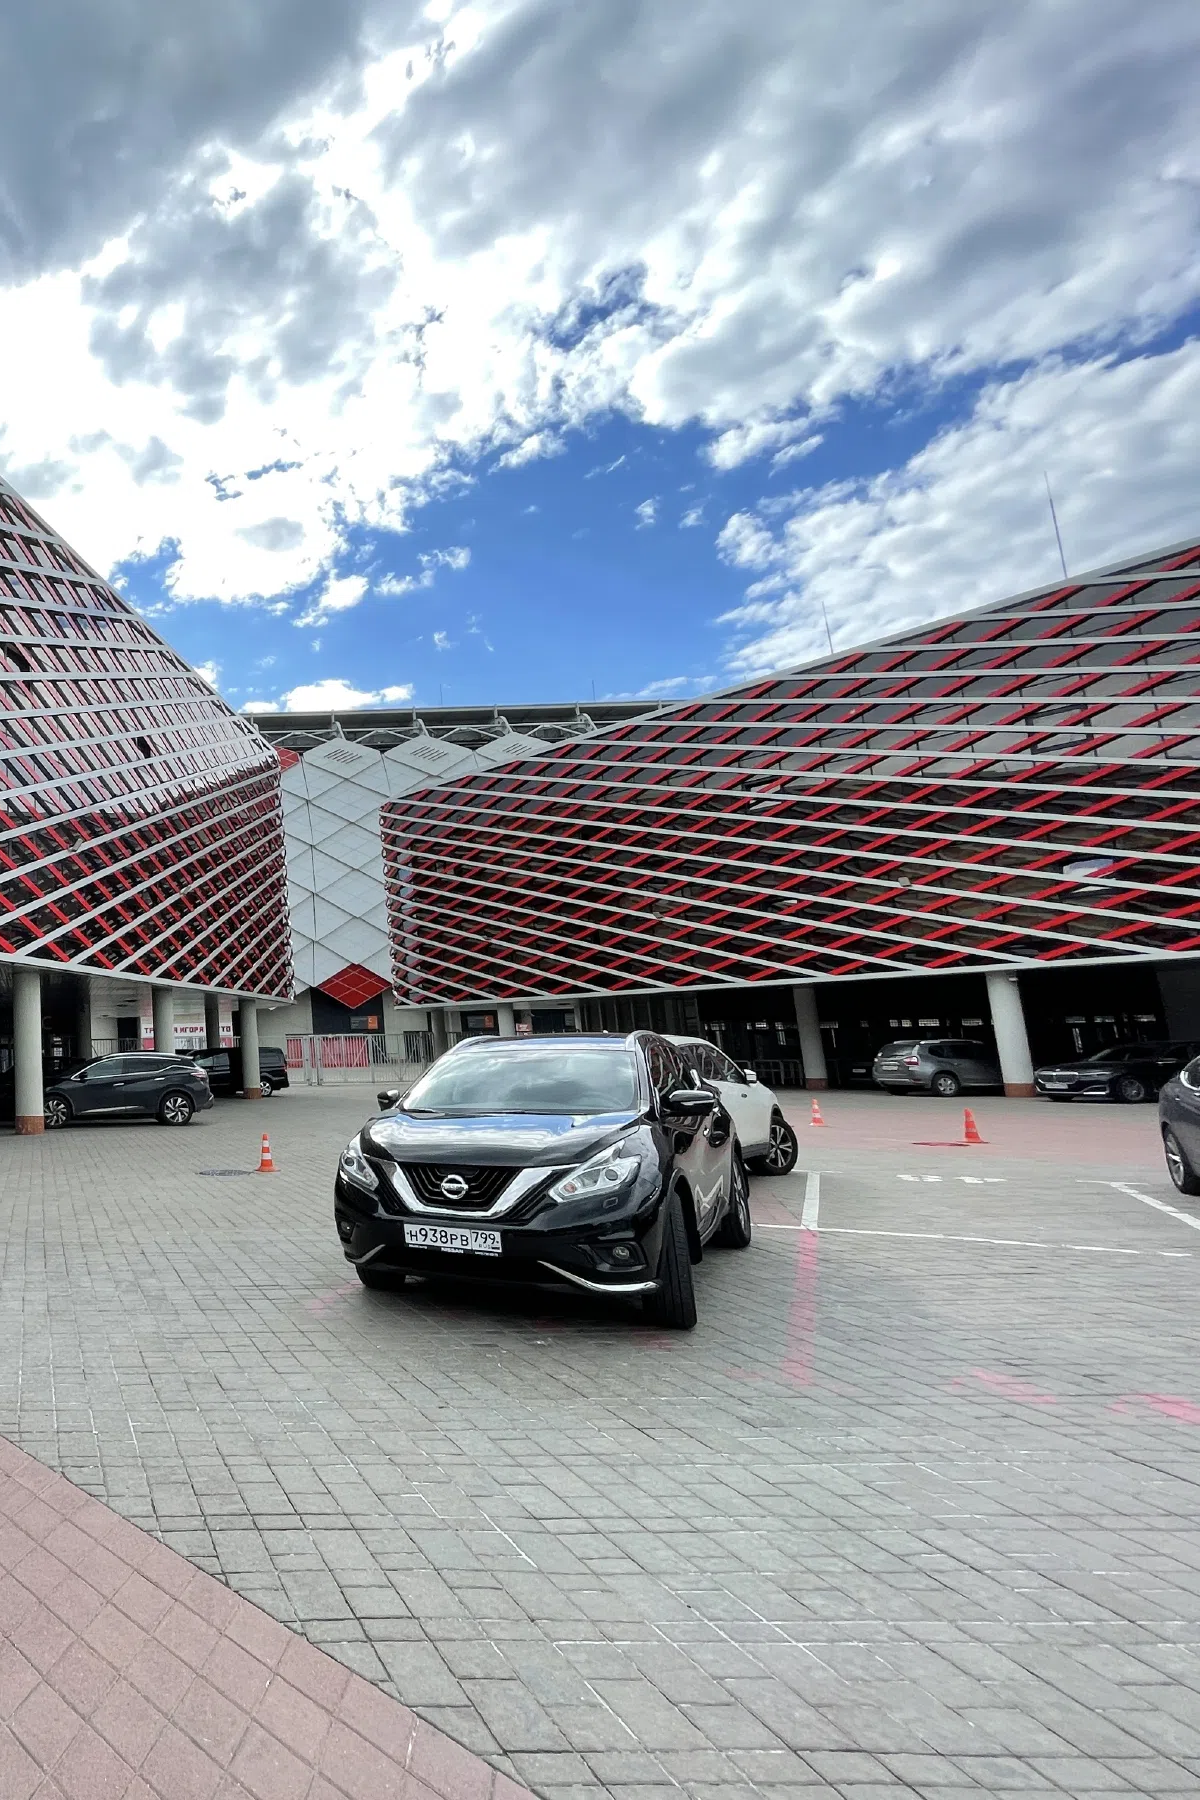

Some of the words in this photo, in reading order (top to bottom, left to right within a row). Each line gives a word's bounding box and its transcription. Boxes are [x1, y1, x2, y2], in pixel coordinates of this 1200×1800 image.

[409, 1227, 469, 1247] Н938РВ
[471, 1231, 496, 1245] 799
[440, 1246, 464, 1254] NISSAN
